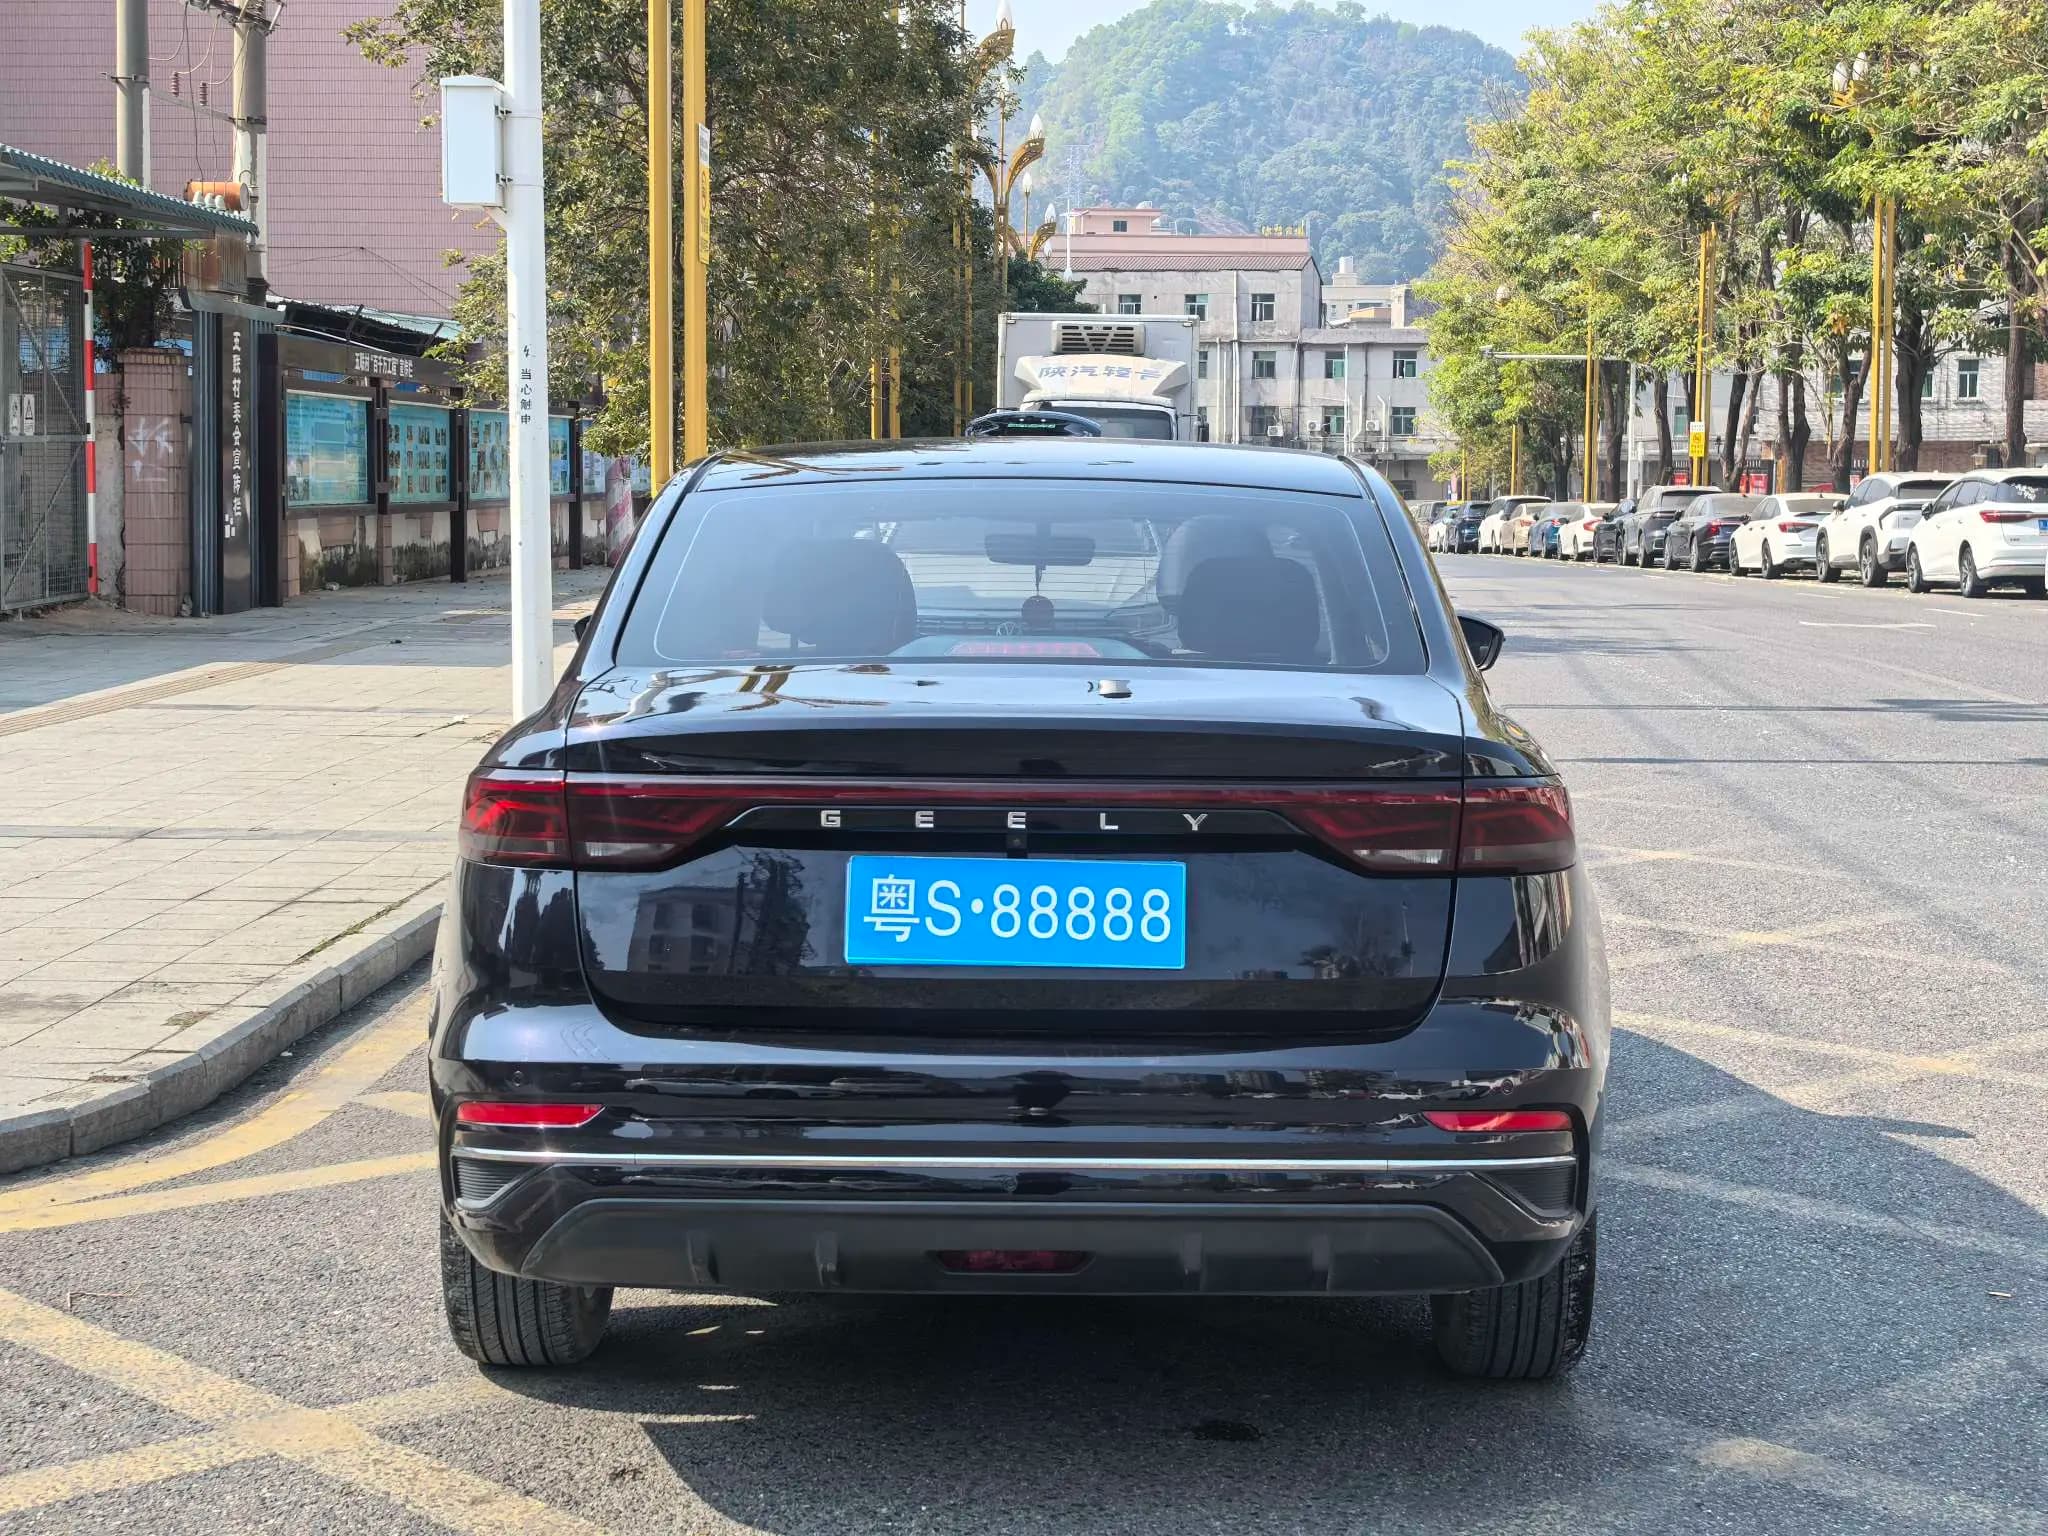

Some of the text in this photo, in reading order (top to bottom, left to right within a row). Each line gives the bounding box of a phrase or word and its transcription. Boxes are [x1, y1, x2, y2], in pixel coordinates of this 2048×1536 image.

[1038, 365, 1162, 380] 陕汽轻卡
[820, 809, 1208, 832] GEELY
